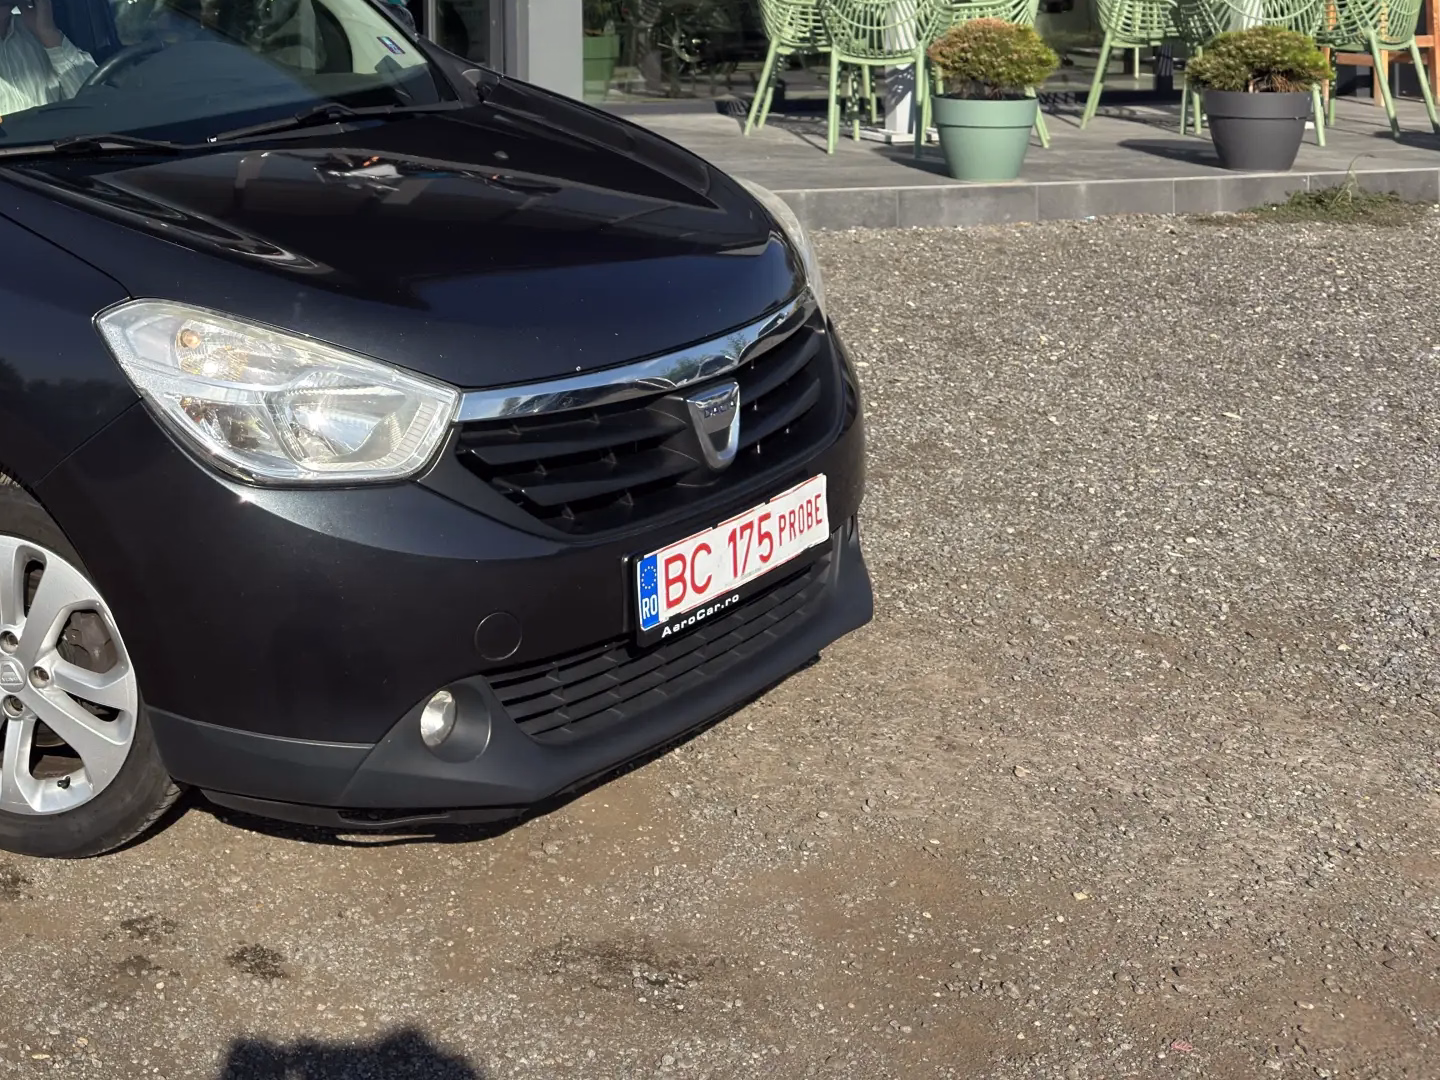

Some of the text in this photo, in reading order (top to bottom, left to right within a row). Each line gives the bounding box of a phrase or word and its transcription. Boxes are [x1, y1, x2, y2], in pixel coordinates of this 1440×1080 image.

[642, 493, 823, 620] RO BC 175 PROBE
